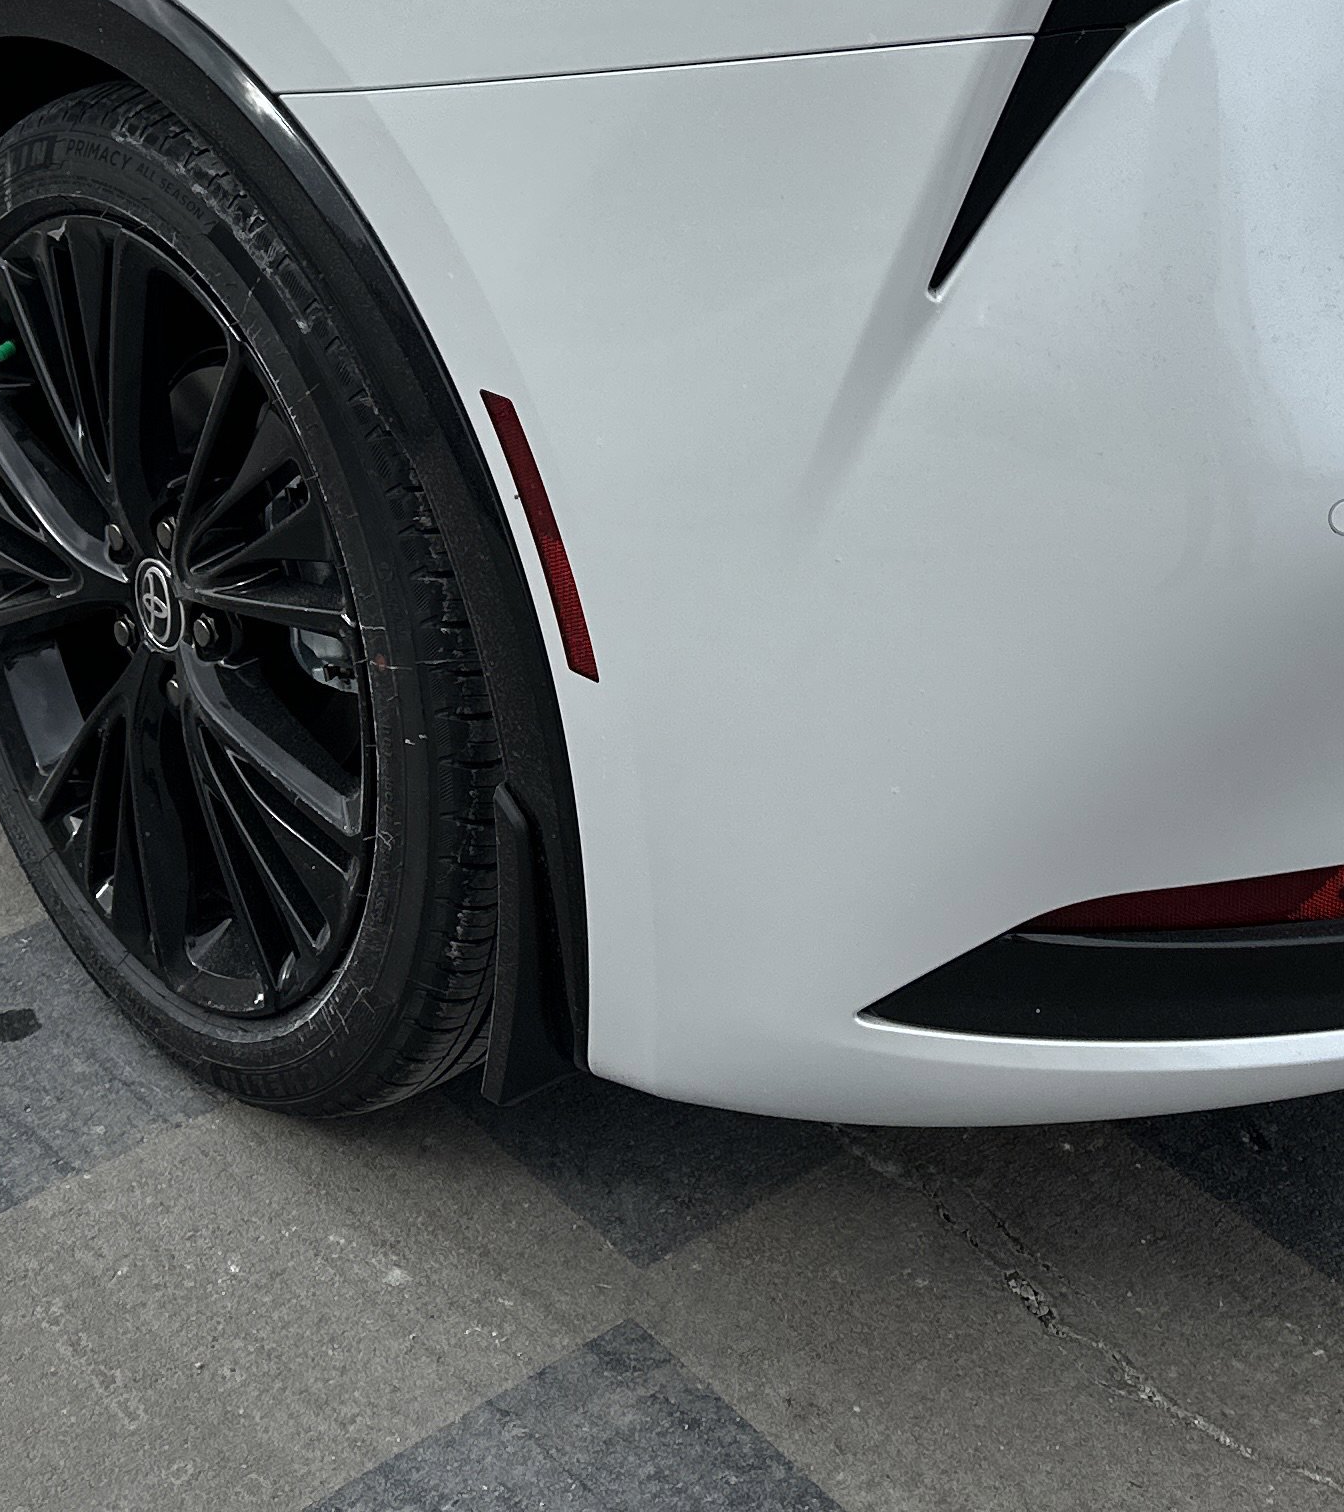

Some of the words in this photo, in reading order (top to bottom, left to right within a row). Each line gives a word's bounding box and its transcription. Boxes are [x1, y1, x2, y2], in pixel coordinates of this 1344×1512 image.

[66, 138, 132, 170] PRIMACY
[136, 162, 157, 183] ALL
[161, 178, 206, 221] SEASON
